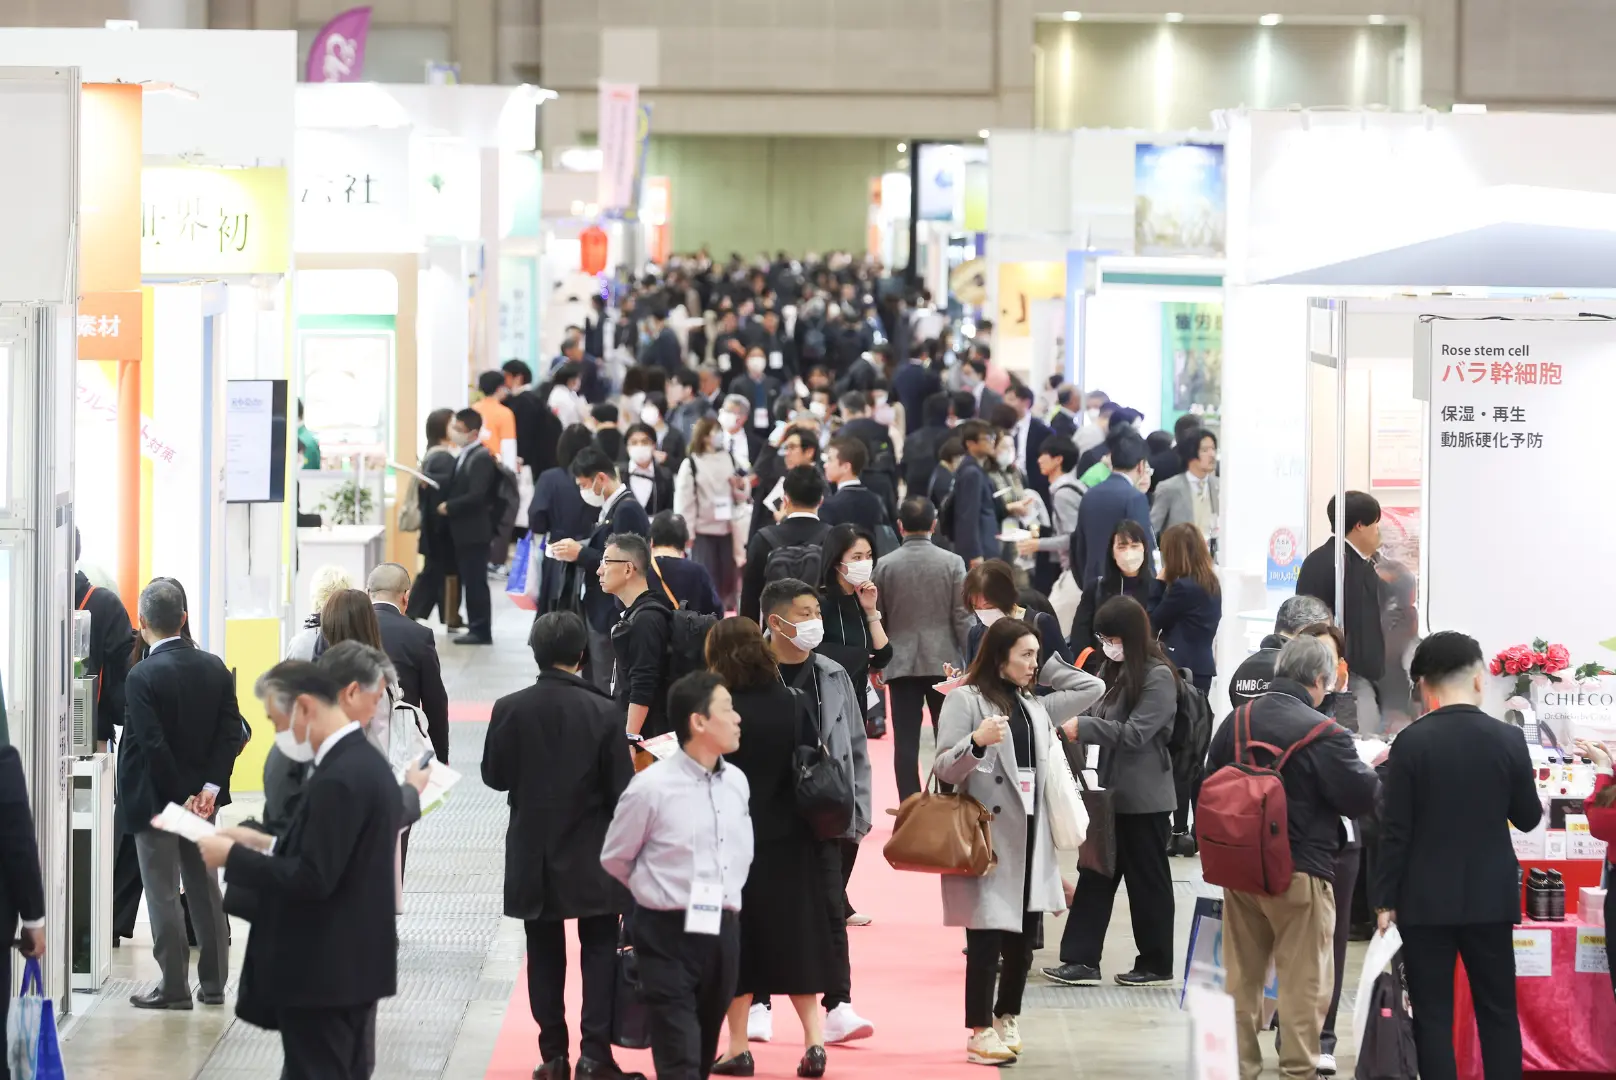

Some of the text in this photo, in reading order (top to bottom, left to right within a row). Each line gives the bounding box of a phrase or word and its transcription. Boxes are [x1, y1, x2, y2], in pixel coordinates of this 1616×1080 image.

[1441, 344, 1530, 356] Rose stem cell
[1441, 361, 1563, 385] バラ幹細胞
[1441, 405, 1526, 423] 保湿・再生
[1441, 431, 1544, 449] 動脈硬化予防
[1544, 692, 1613, 706] CHIECO
